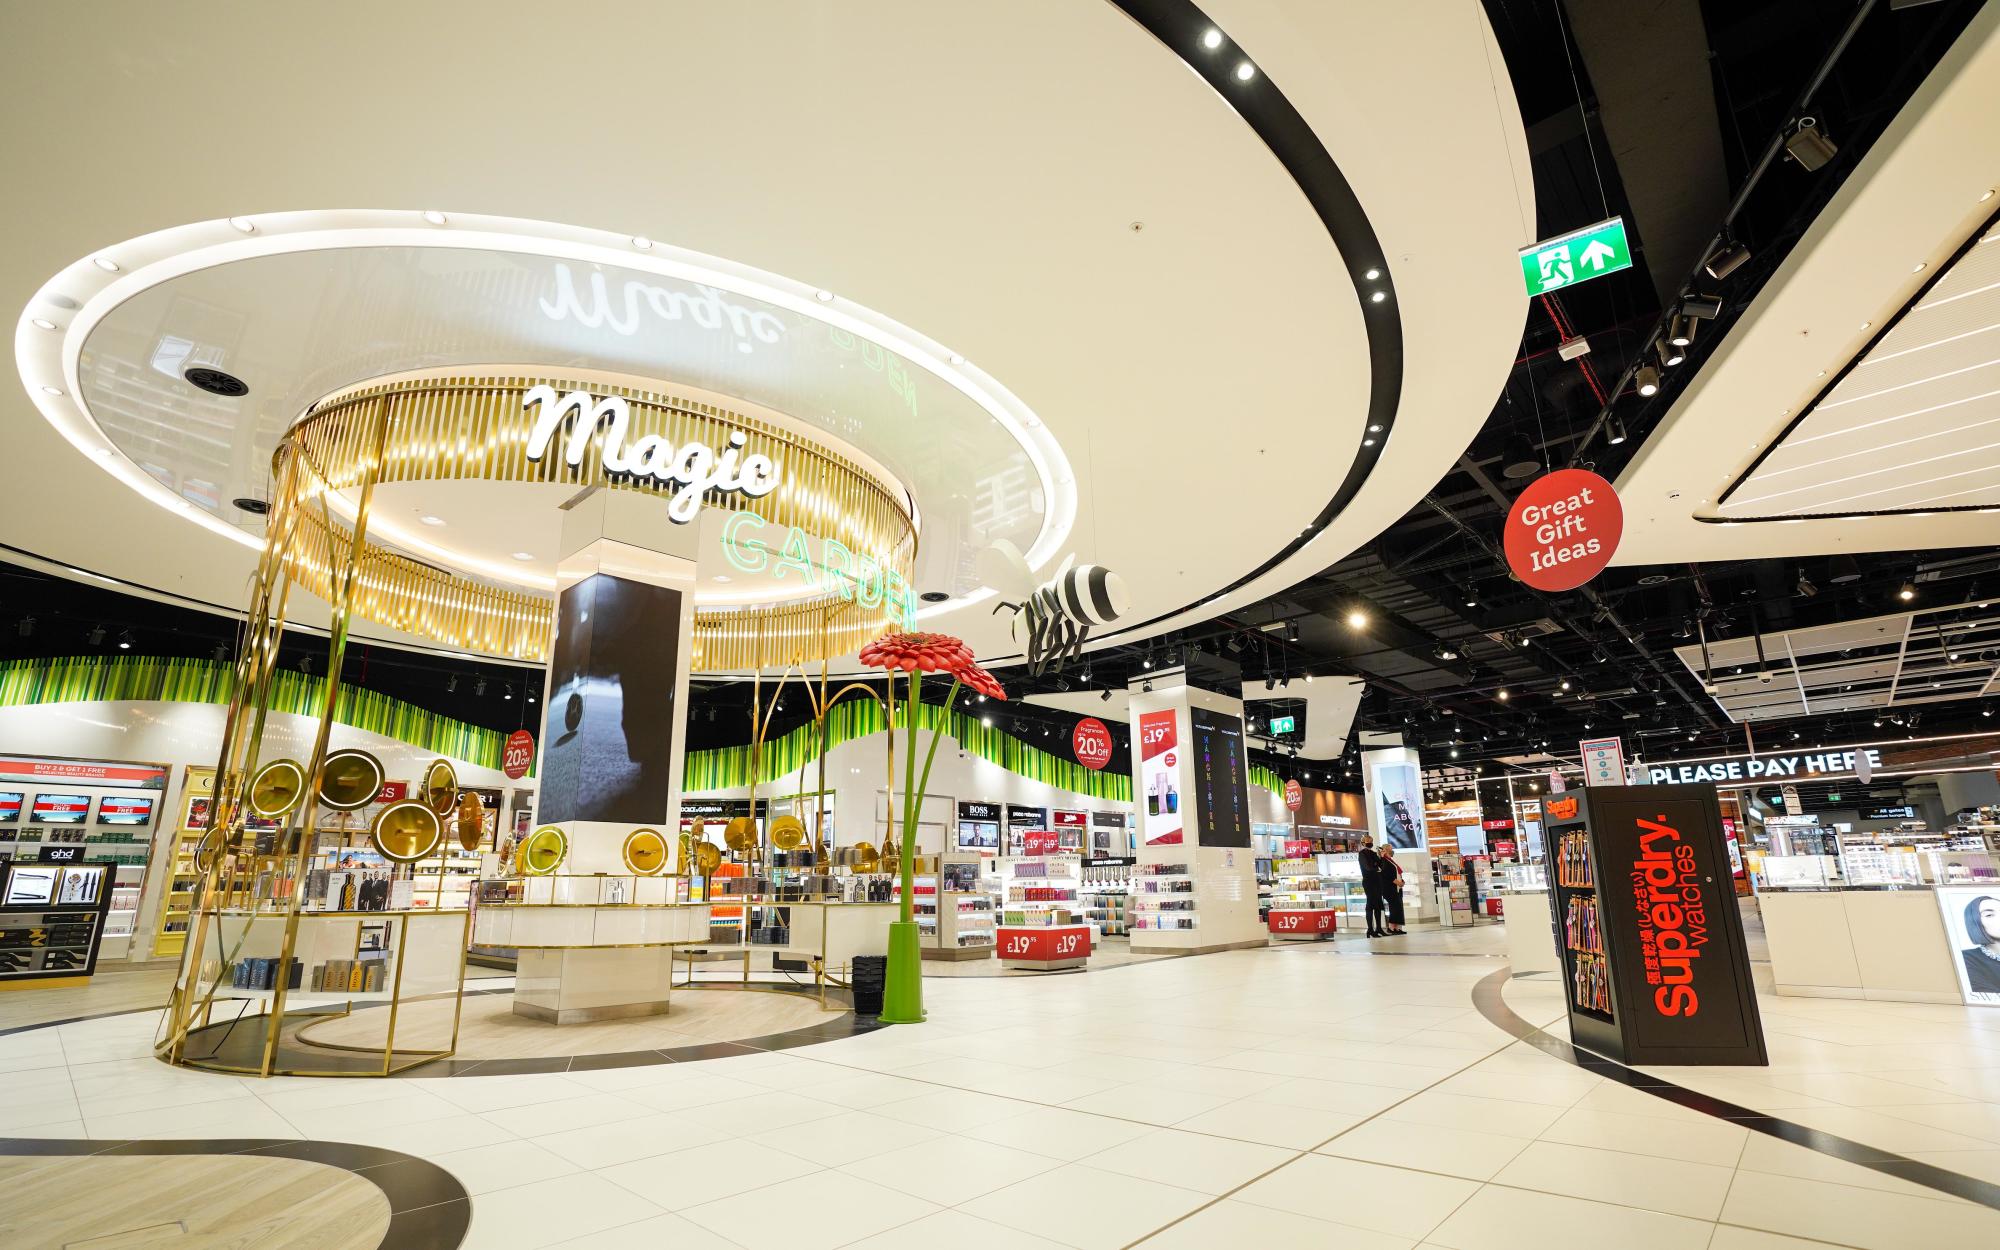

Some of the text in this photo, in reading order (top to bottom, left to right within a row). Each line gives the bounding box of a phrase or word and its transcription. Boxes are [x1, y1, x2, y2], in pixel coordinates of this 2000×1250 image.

[522, 384, 780, 525] Magic
[1521, 487, 1594, 526] Great
[1535, 514, 1587, 546] Gift
[1530, 535, 1601, 573] Ideas
[721, 510, 917, 632] GARDEN
[1080, 726, 1104, 734] Fragrances
[520, 756, 530, 765] Off
[1098, 748, 1108, 756] Off
[1651, 762, 1742, 784] PLEASE
[1747, 757, 1798, 777] PAY
[970, 806, 988, 814] BOSS
[51, 849, 74, 859] ghd
[1675, 845, 1709, 946] watches
[1007, 936, 1037, 954] £19.95
